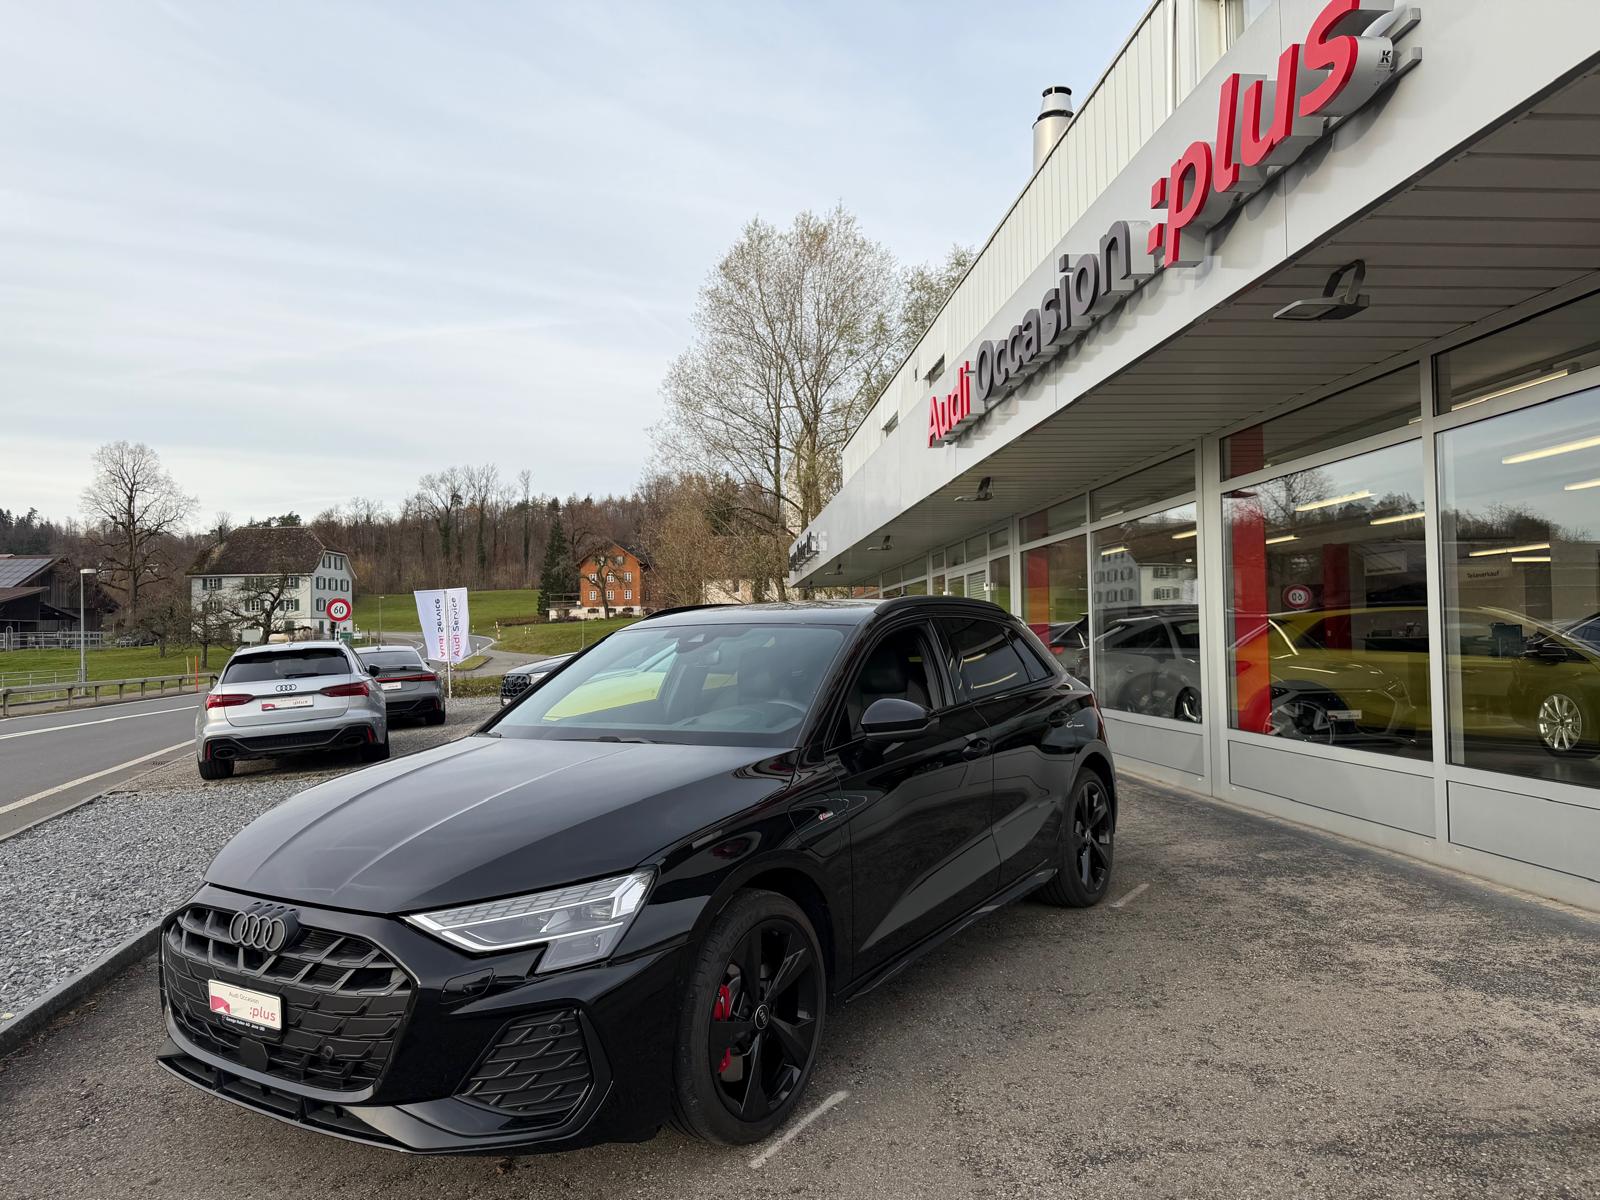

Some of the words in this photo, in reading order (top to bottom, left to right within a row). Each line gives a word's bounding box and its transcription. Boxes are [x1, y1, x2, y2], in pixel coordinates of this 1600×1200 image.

[928, 360, 971, 448] Audi
[975, 220, 1131, 400] Occasion
[333, 605, 344, 615] 60
[451, 597, 460, 632] Service
[249, 1006, 276, 1022] :plus
